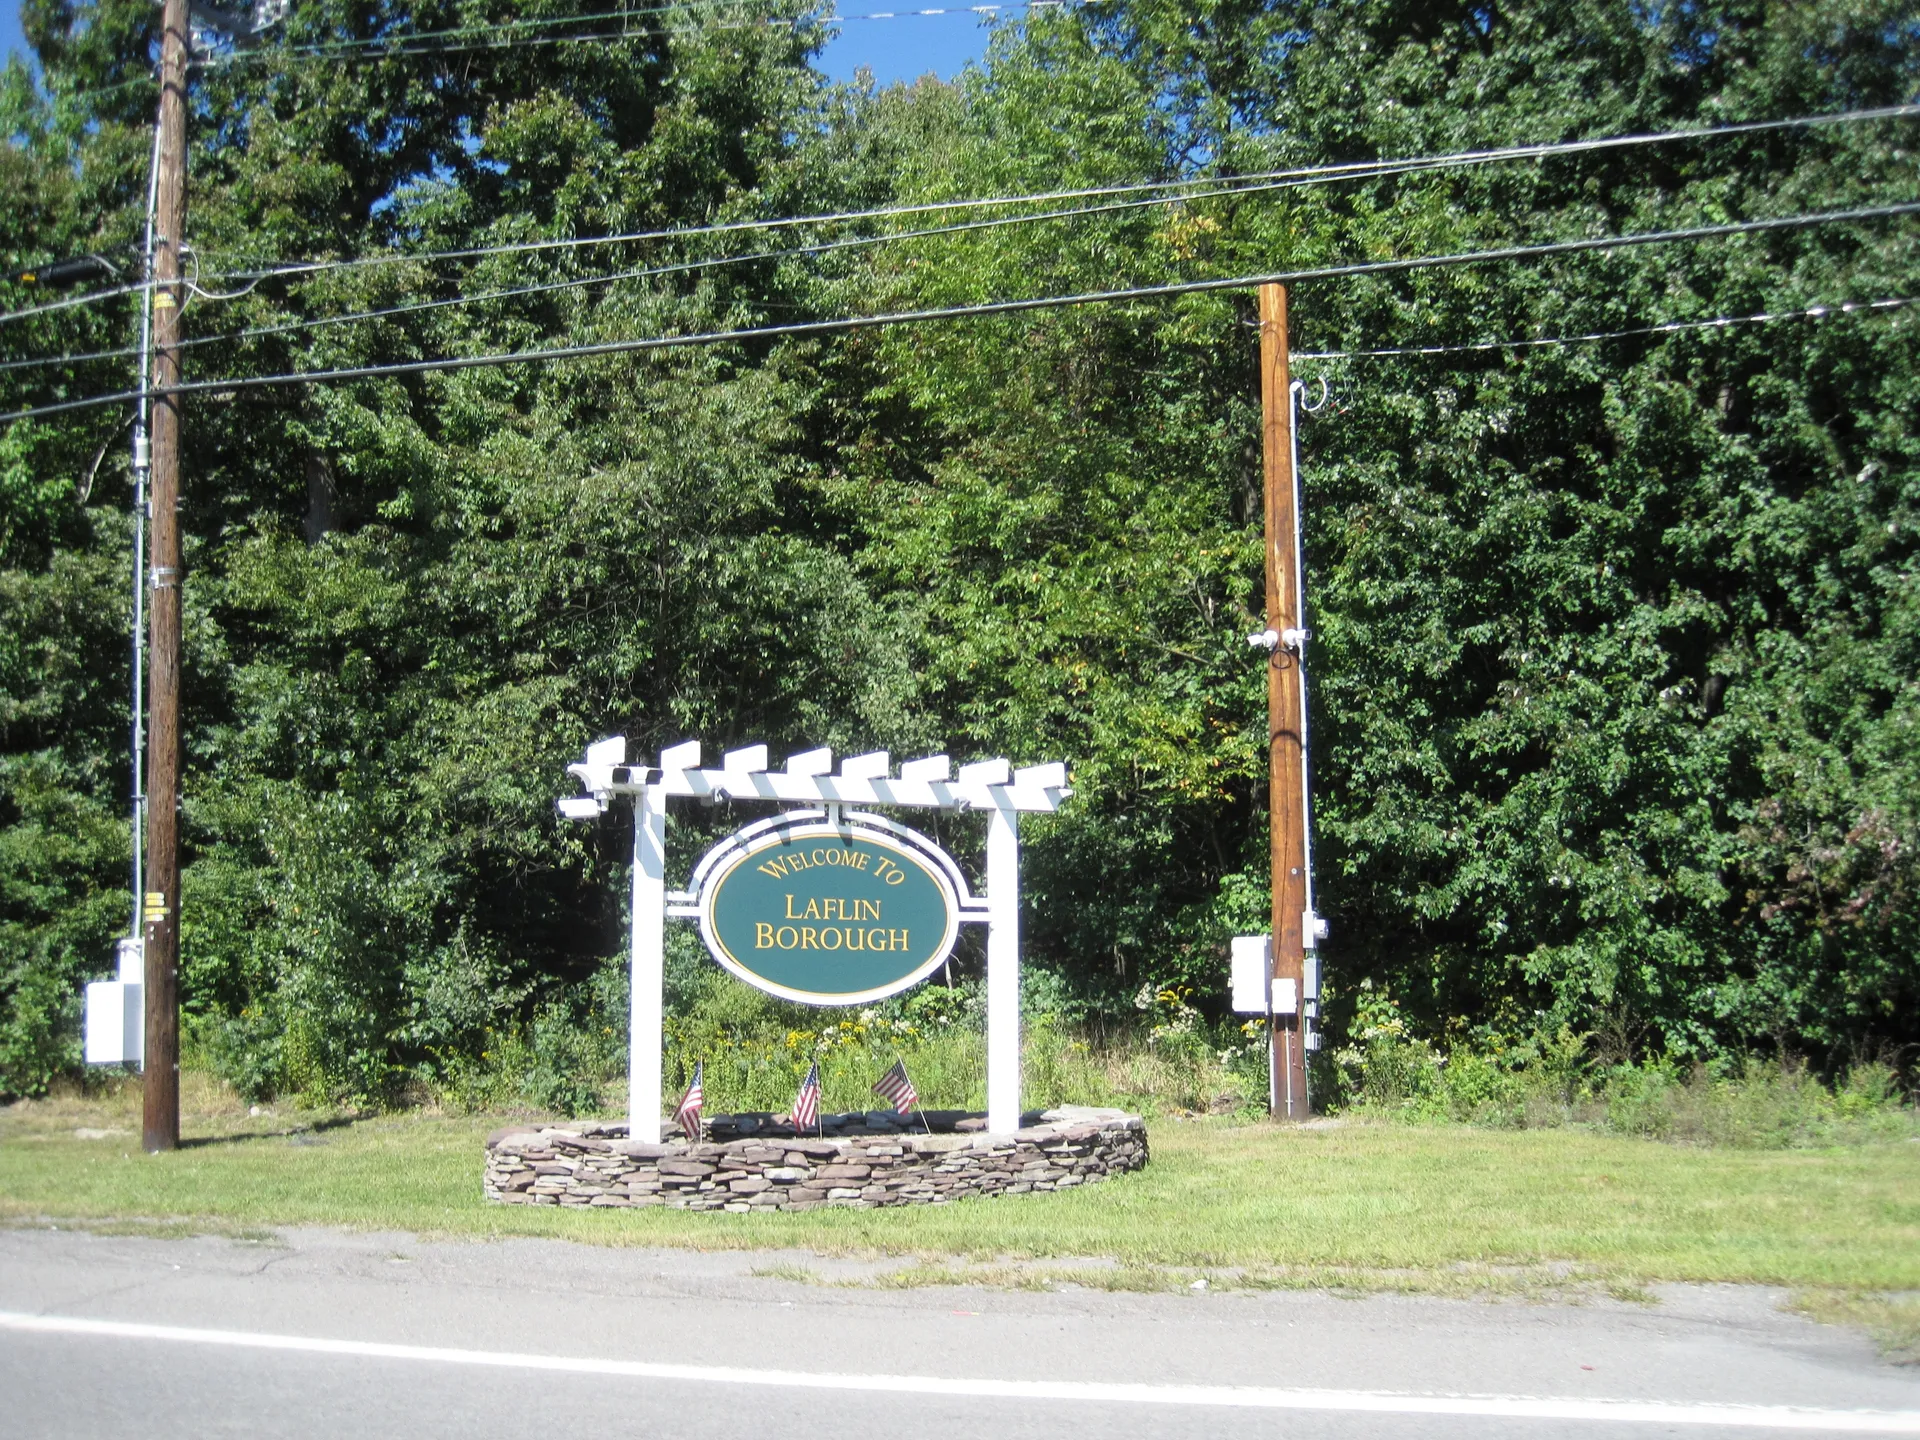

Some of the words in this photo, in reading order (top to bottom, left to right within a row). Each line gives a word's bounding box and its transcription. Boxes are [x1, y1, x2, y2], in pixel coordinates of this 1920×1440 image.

[757, 848, 871, 880] WELCOME
[873, 856, 905, 886] TO
[785, 894, 881, 921] LAFLIN
[755, 923, 909, 951] BOROUGH
